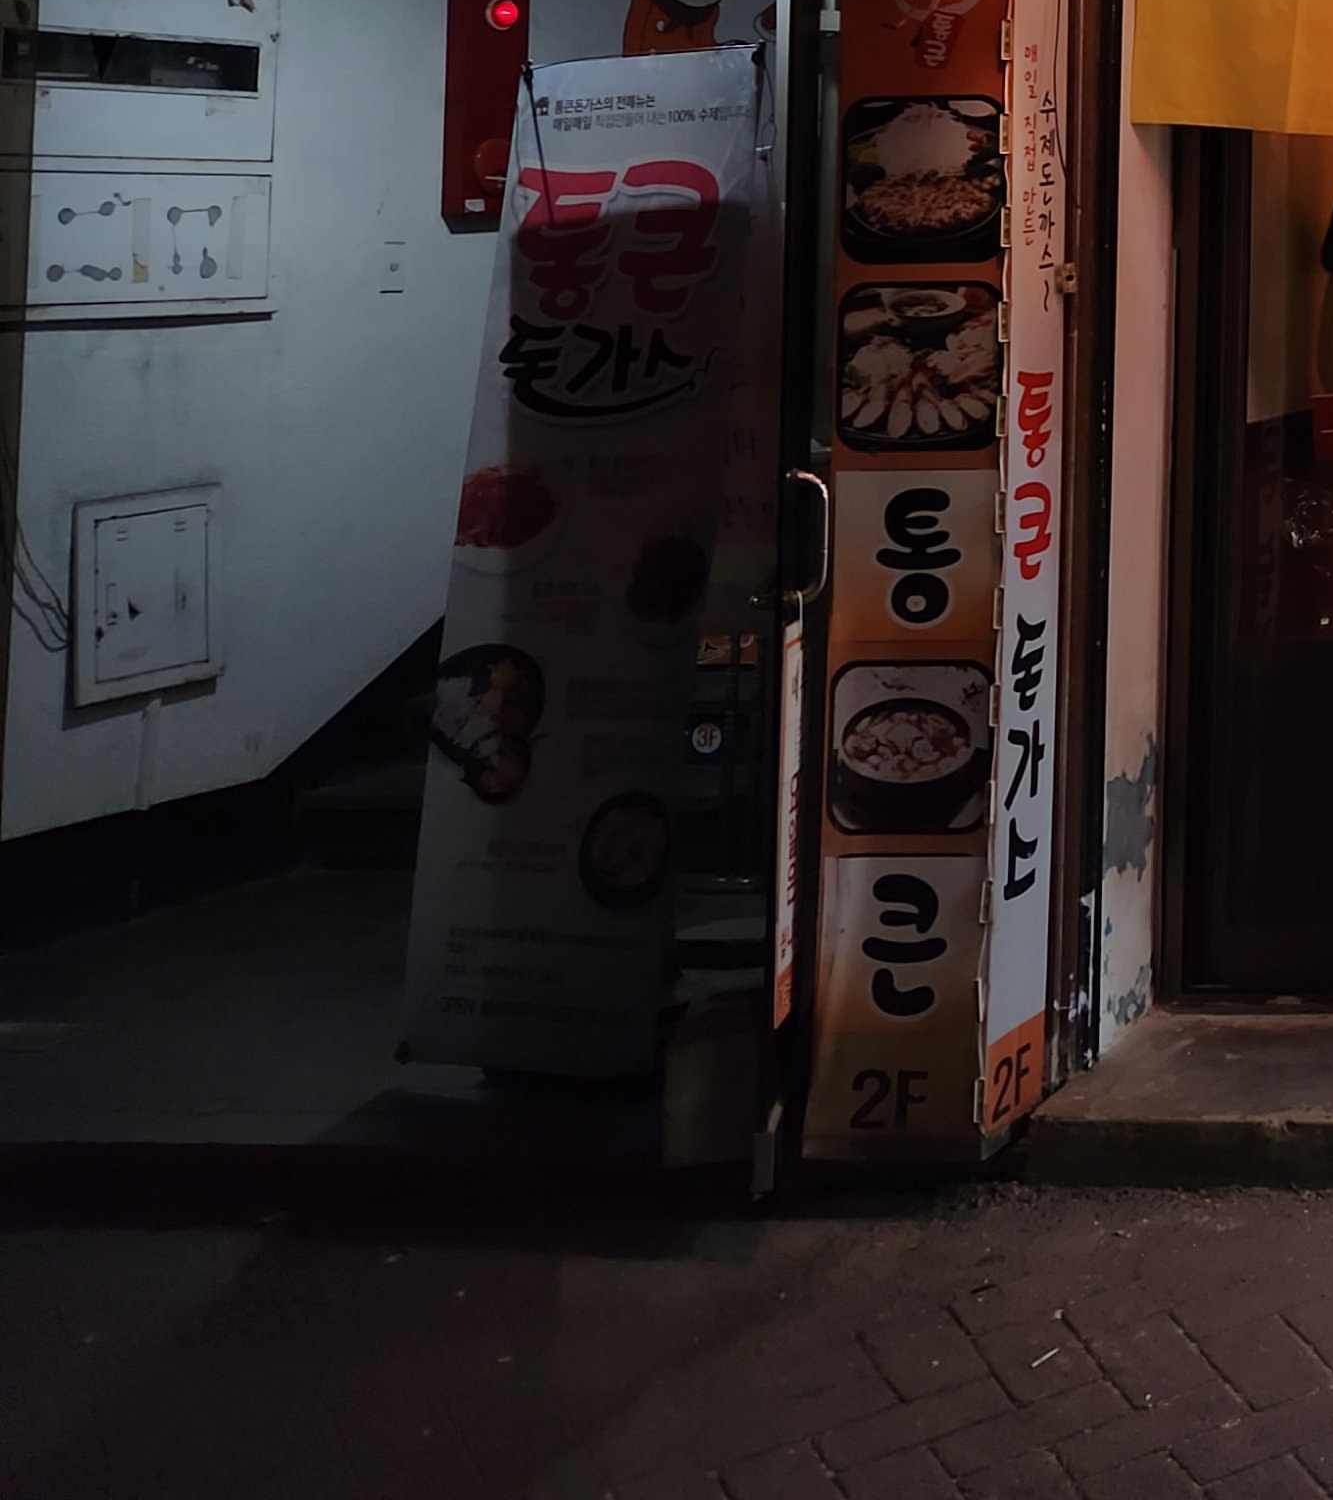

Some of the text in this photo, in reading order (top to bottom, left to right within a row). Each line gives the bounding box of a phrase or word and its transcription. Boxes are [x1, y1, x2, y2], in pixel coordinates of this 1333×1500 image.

[518, 160, 720, 320] 통큰
[500, 314, 694, 417] 돈가스
[1014, 372, 1054, 580] 통큰
[697, 728, 717, 747] 3F
[849, 1070, 929, 1129] 2F
[990, 1044, 1032, 1124] 2F
